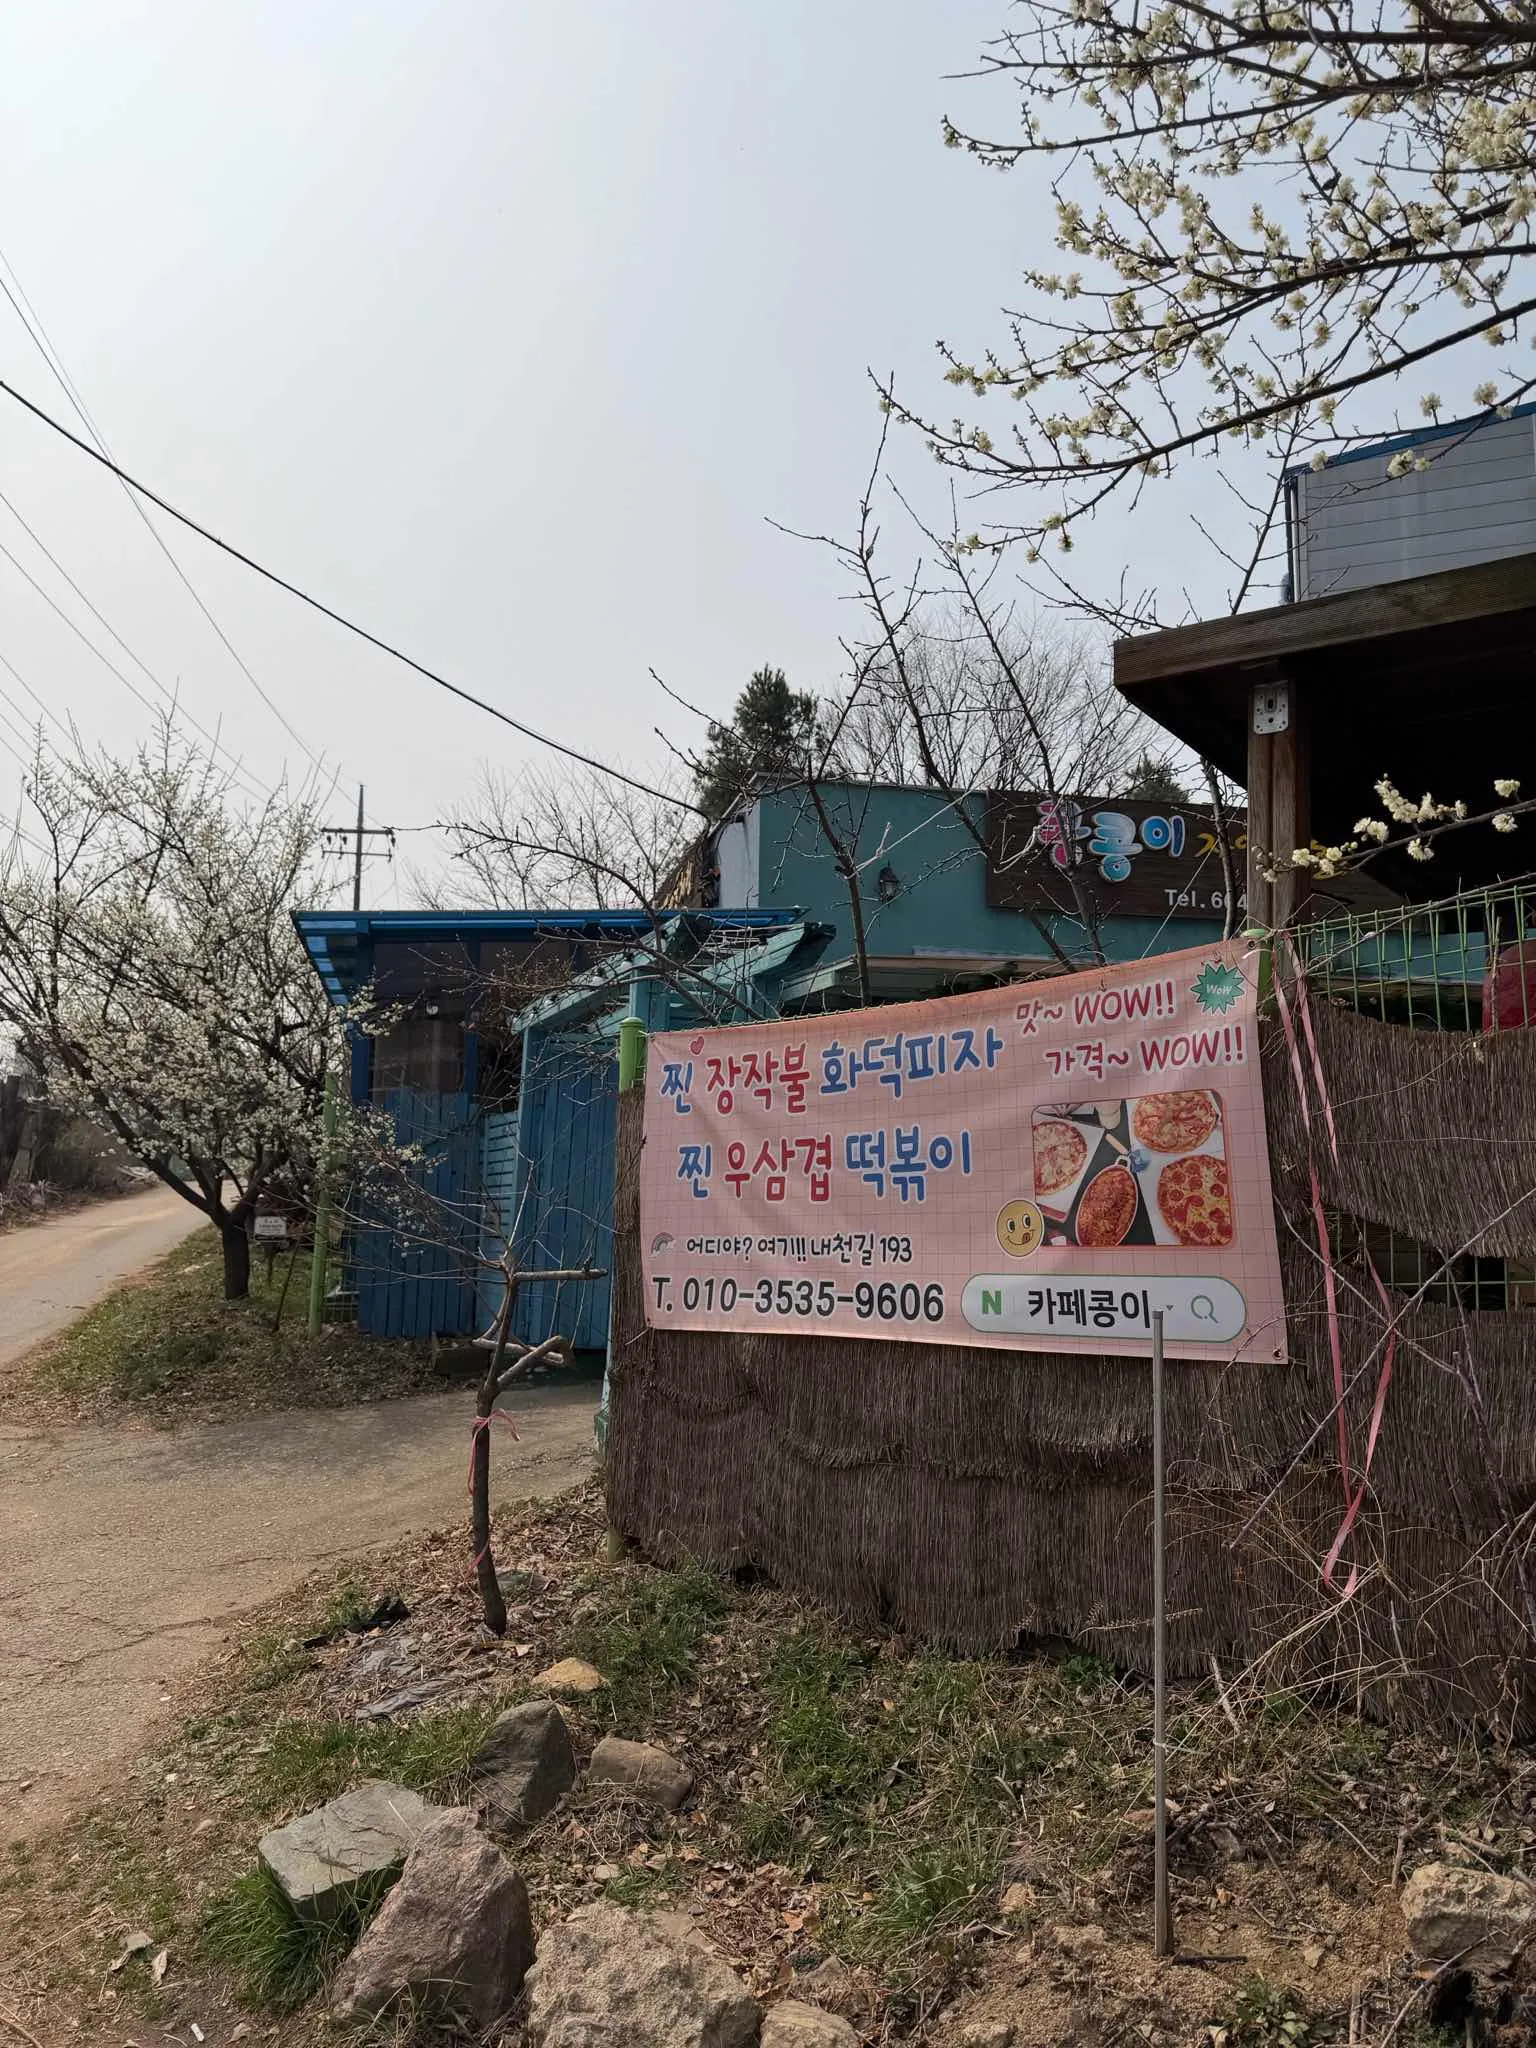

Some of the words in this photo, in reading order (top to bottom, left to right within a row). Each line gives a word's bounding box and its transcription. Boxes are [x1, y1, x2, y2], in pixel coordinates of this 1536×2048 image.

[1016, 1000, 1063, 1035] 맛~
[1074, 981, 1175, 1025] WOW!!
[661, 1062, 693, 1114] 찐
[706, 1044, 810, 1115] 장작불
[820, 1027, 1004, 1098] 화덕피자
[1045, 1041, 1129, 1080] 가격~
[1140, 1026, 1244, 1071] WOW!!
[677, 1144, 712, 1198] 찐
[724, 1134, 832, 1202] 우삼겹
[845, 1125, 972, 1202] 떡볶이
[686, 1236, 753, 1261] 어디야?
[810, 1232, 874, 1267] 내천길
[879, 1236, 912, 1263] 193
[652, 1277, 672, 1312] T.
[682, 1277, 944, 1322] 010-3535-9606
[981, 1289, 1003, 1315] N
[1027, 1287, 1151, 1329] 카페콩이
